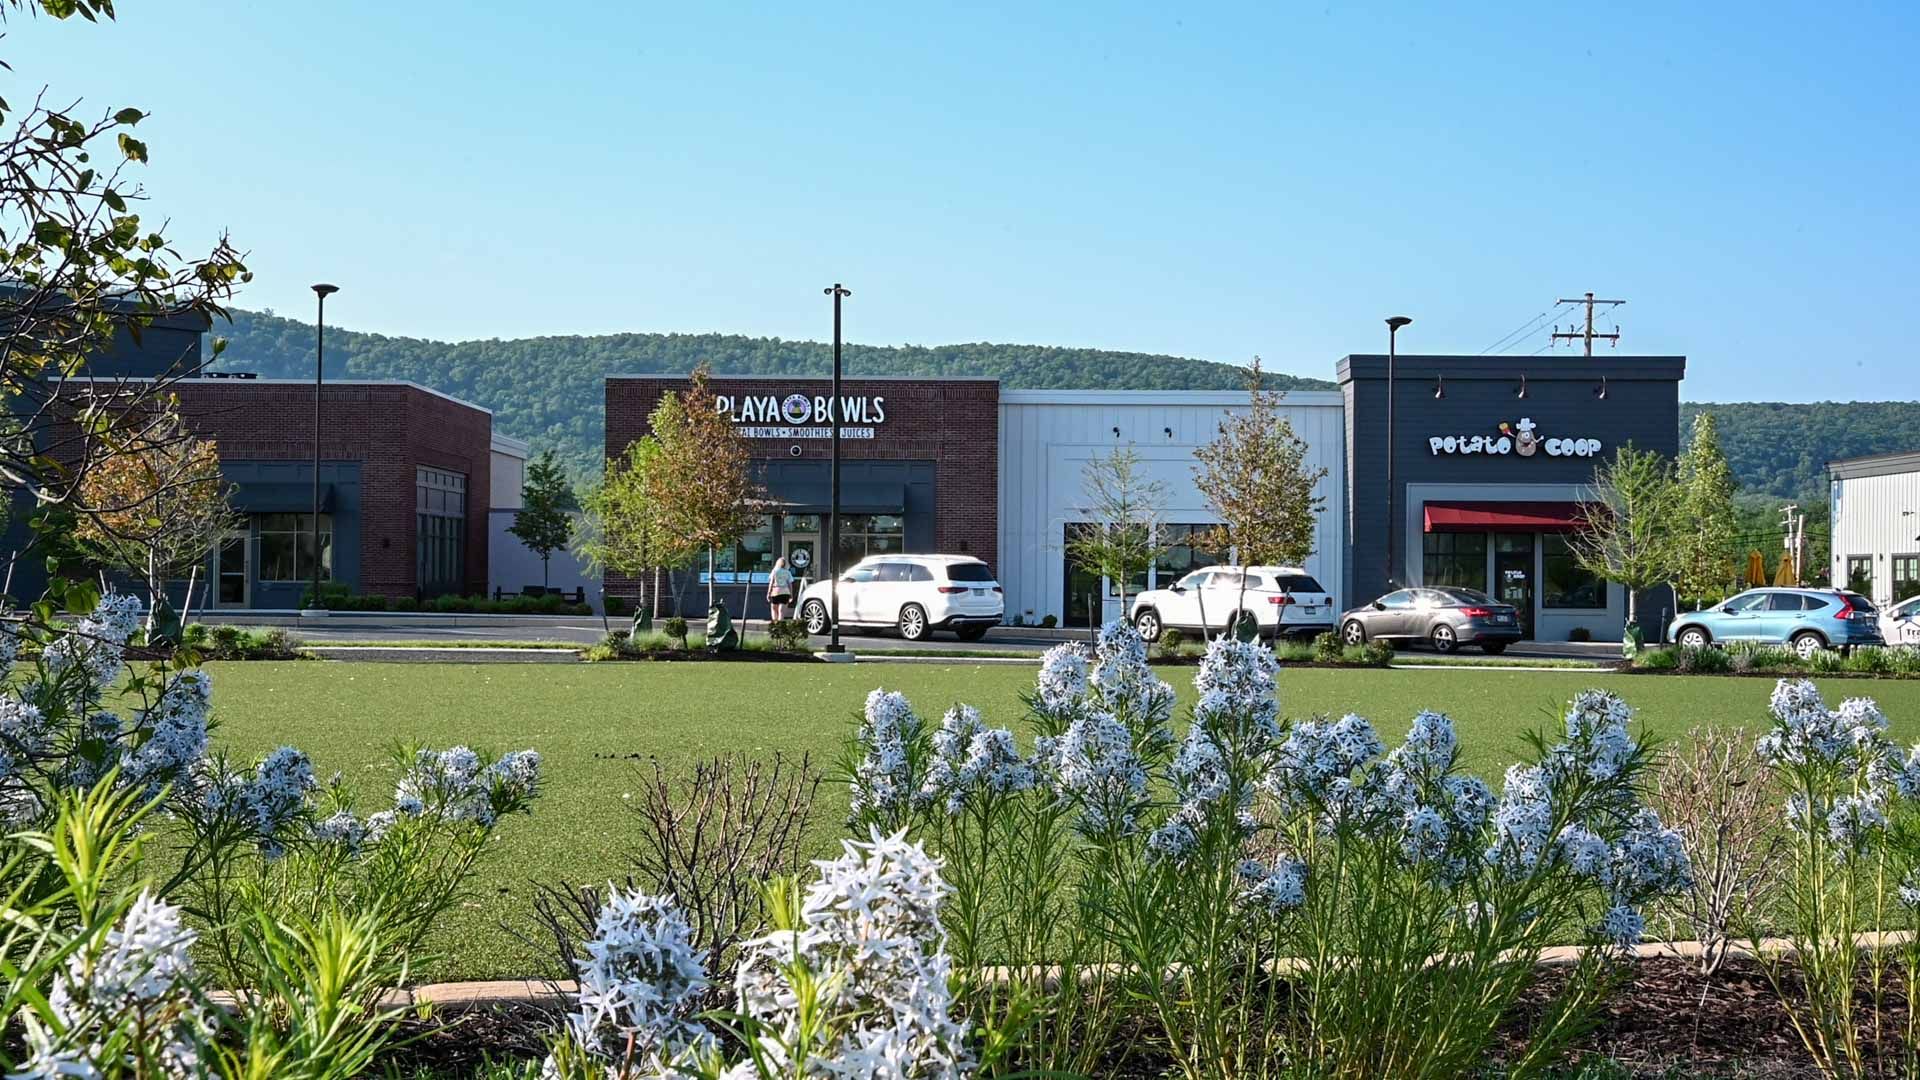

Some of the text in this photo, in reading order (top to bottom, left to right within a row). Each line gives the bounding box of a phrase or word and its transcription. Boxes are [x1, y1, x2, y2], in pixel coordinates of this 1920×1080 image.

[716, 396, 780, 422] PLAYA
[754, 427, 780, 437] BOWLS
[788, 428, 833, 437] SMOOTHIES
[841, 428, 871, 438] JUICES
